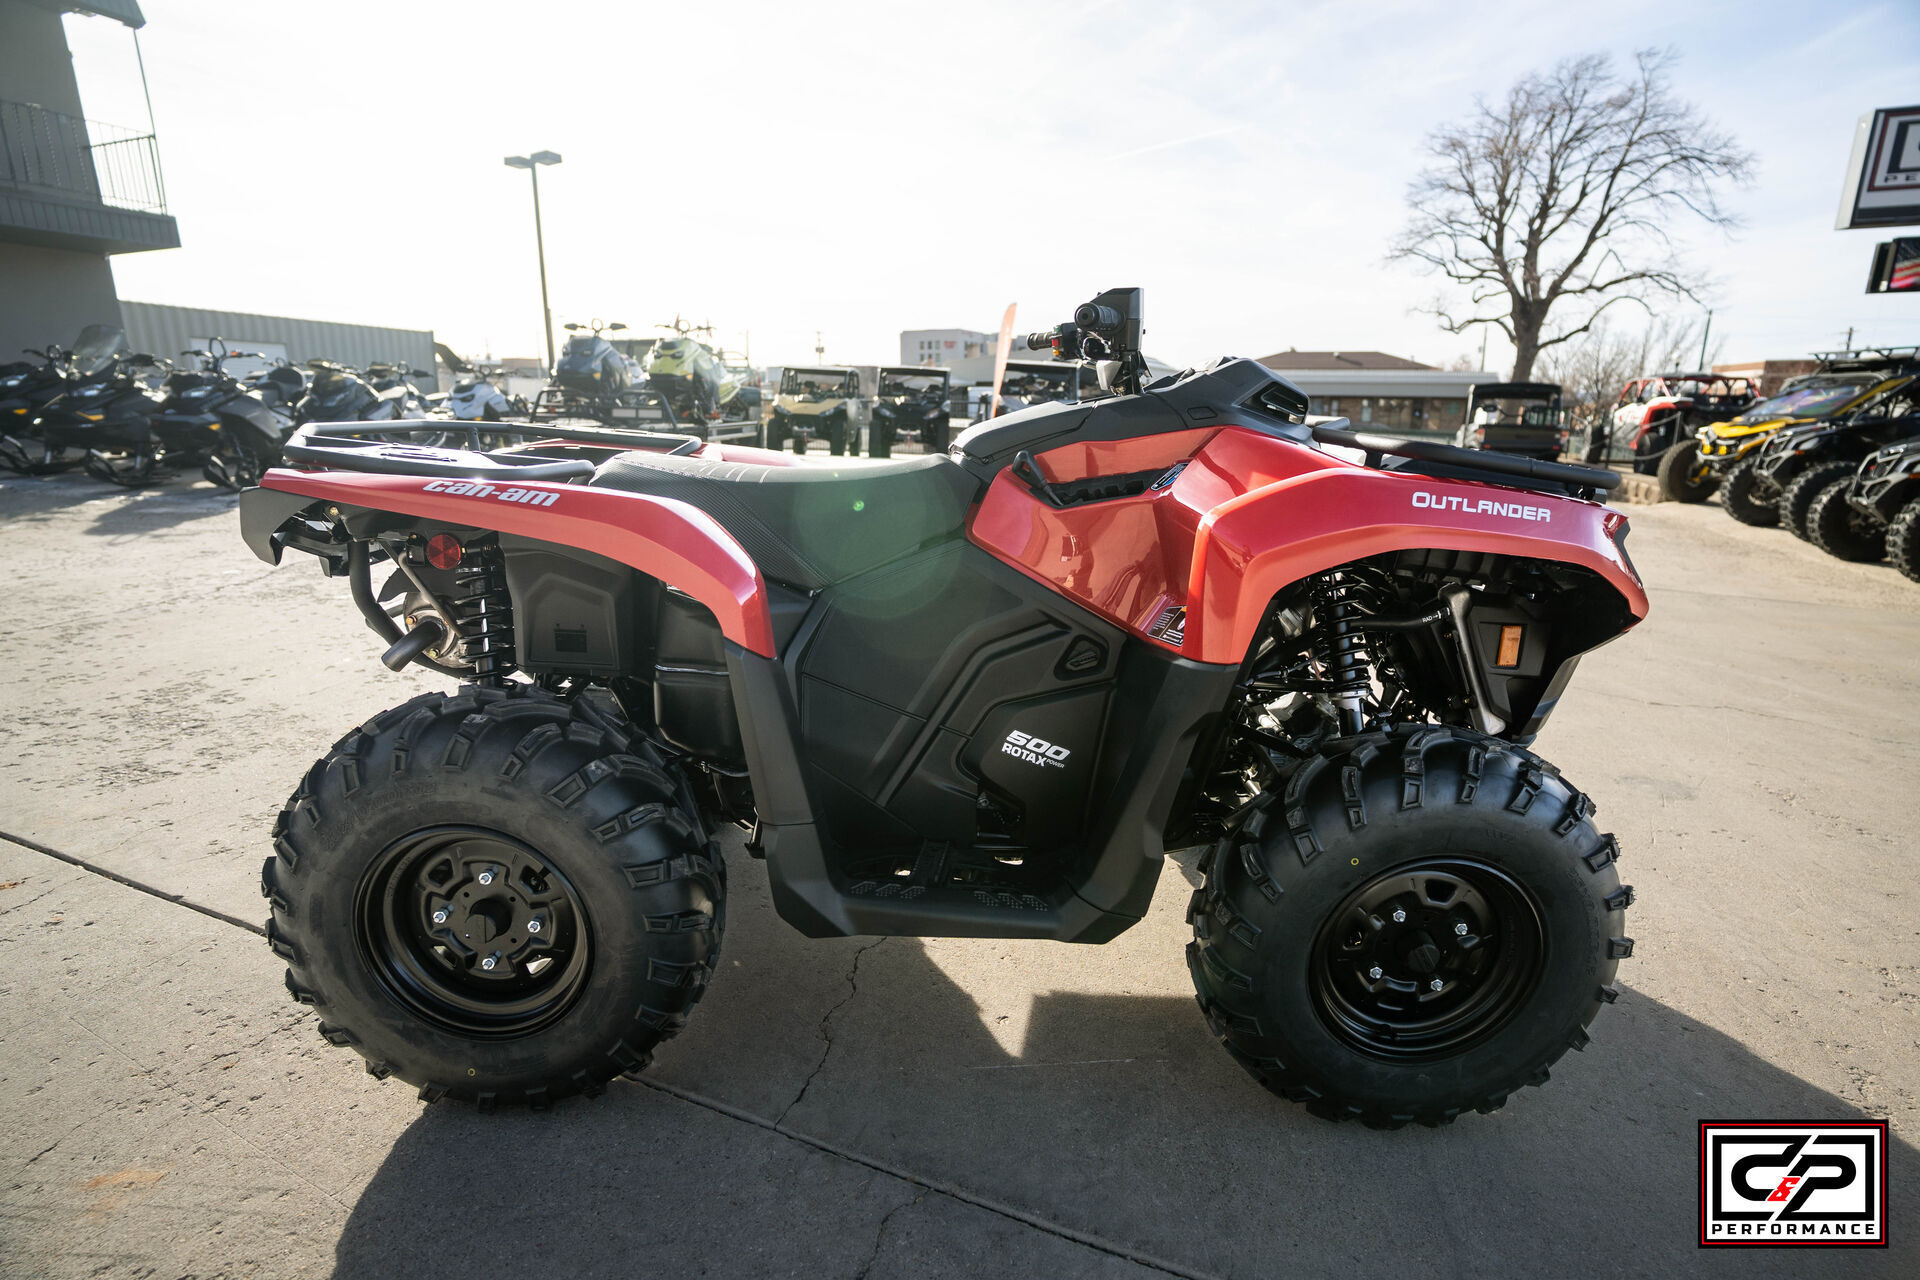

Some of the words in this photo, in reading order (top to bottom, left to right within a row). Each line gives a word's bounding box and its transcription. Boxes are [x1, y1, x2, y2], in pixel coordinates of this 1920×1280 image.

[422, 480, 561, 507] can-am
[1411, 491, 1551, 523] OUTLANDER
[1001, 742, 1047, 767] ROTAX
[1046, 759, 1064, 768] POWER
[1006, 730, 1071, 760] 500
